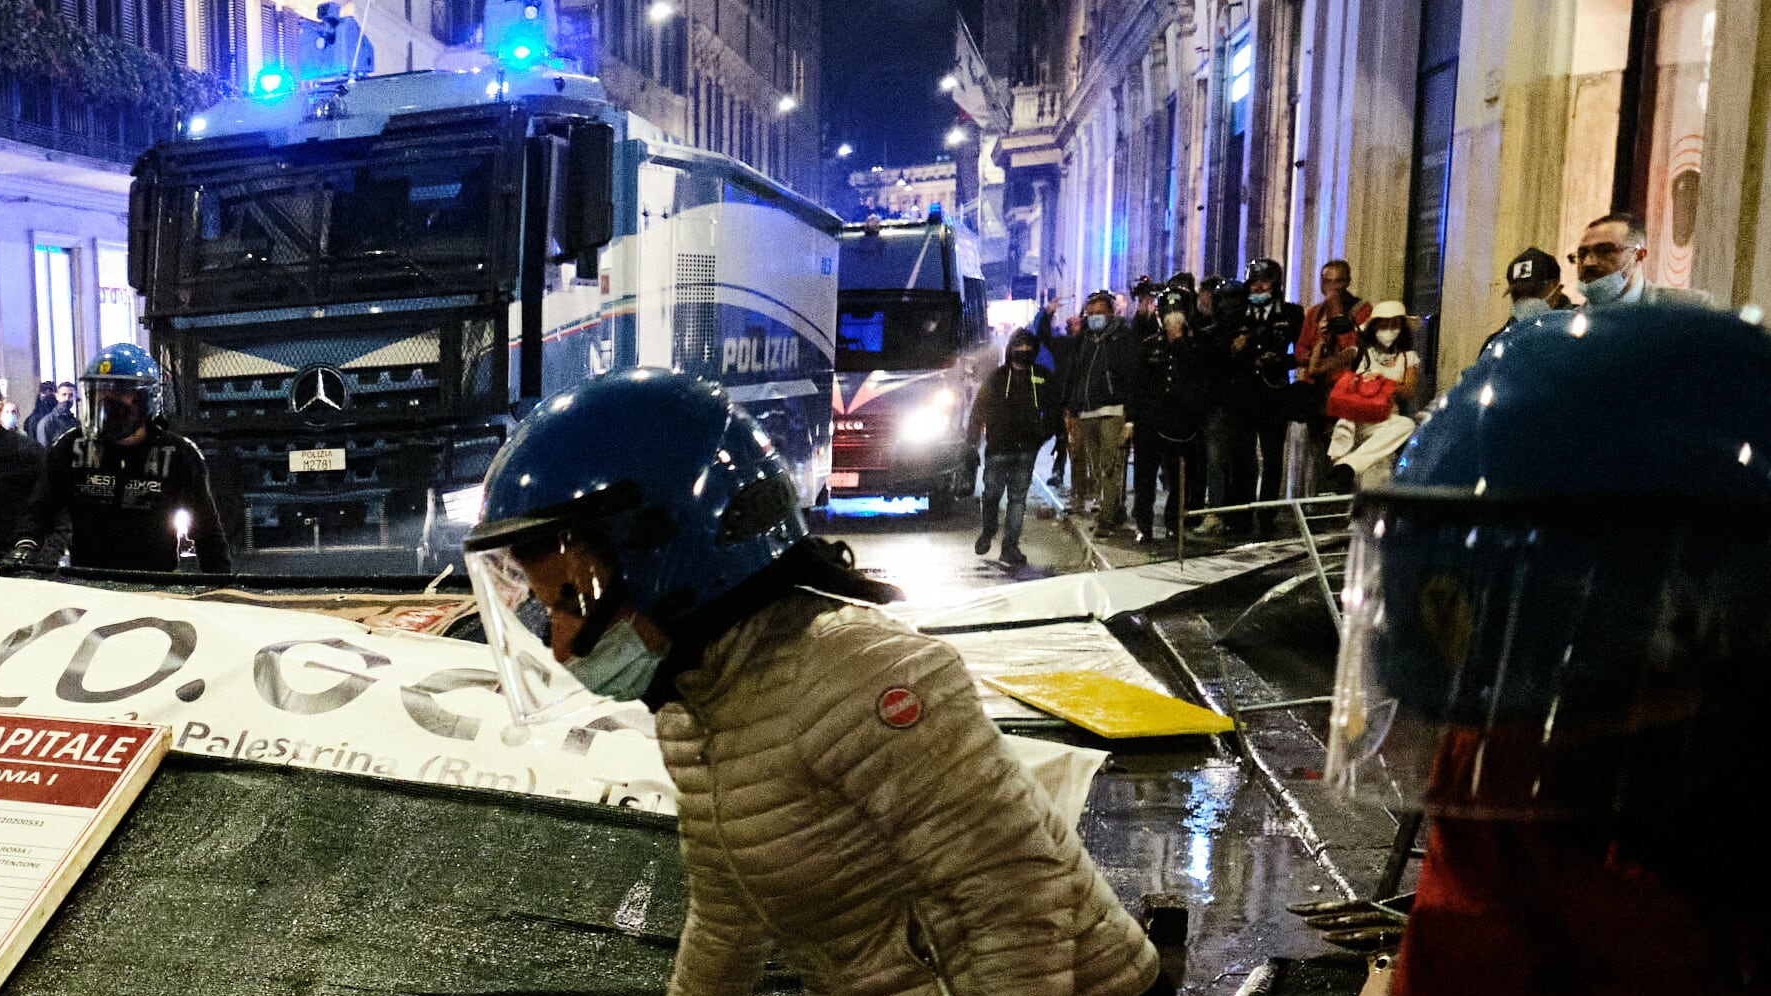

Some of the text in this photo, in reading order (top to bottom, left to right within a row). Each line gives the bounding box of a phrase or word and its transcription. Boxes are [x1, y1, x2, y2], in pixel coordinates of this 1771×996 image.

[722, 337, 799, 374] POLIZIA
[301, 450, 333, 459] POLIZIA
[177, 721, 397, 777] Palestrina
[46, 773, 59, 786] I
[0, 845, 27, 854] ROMA
